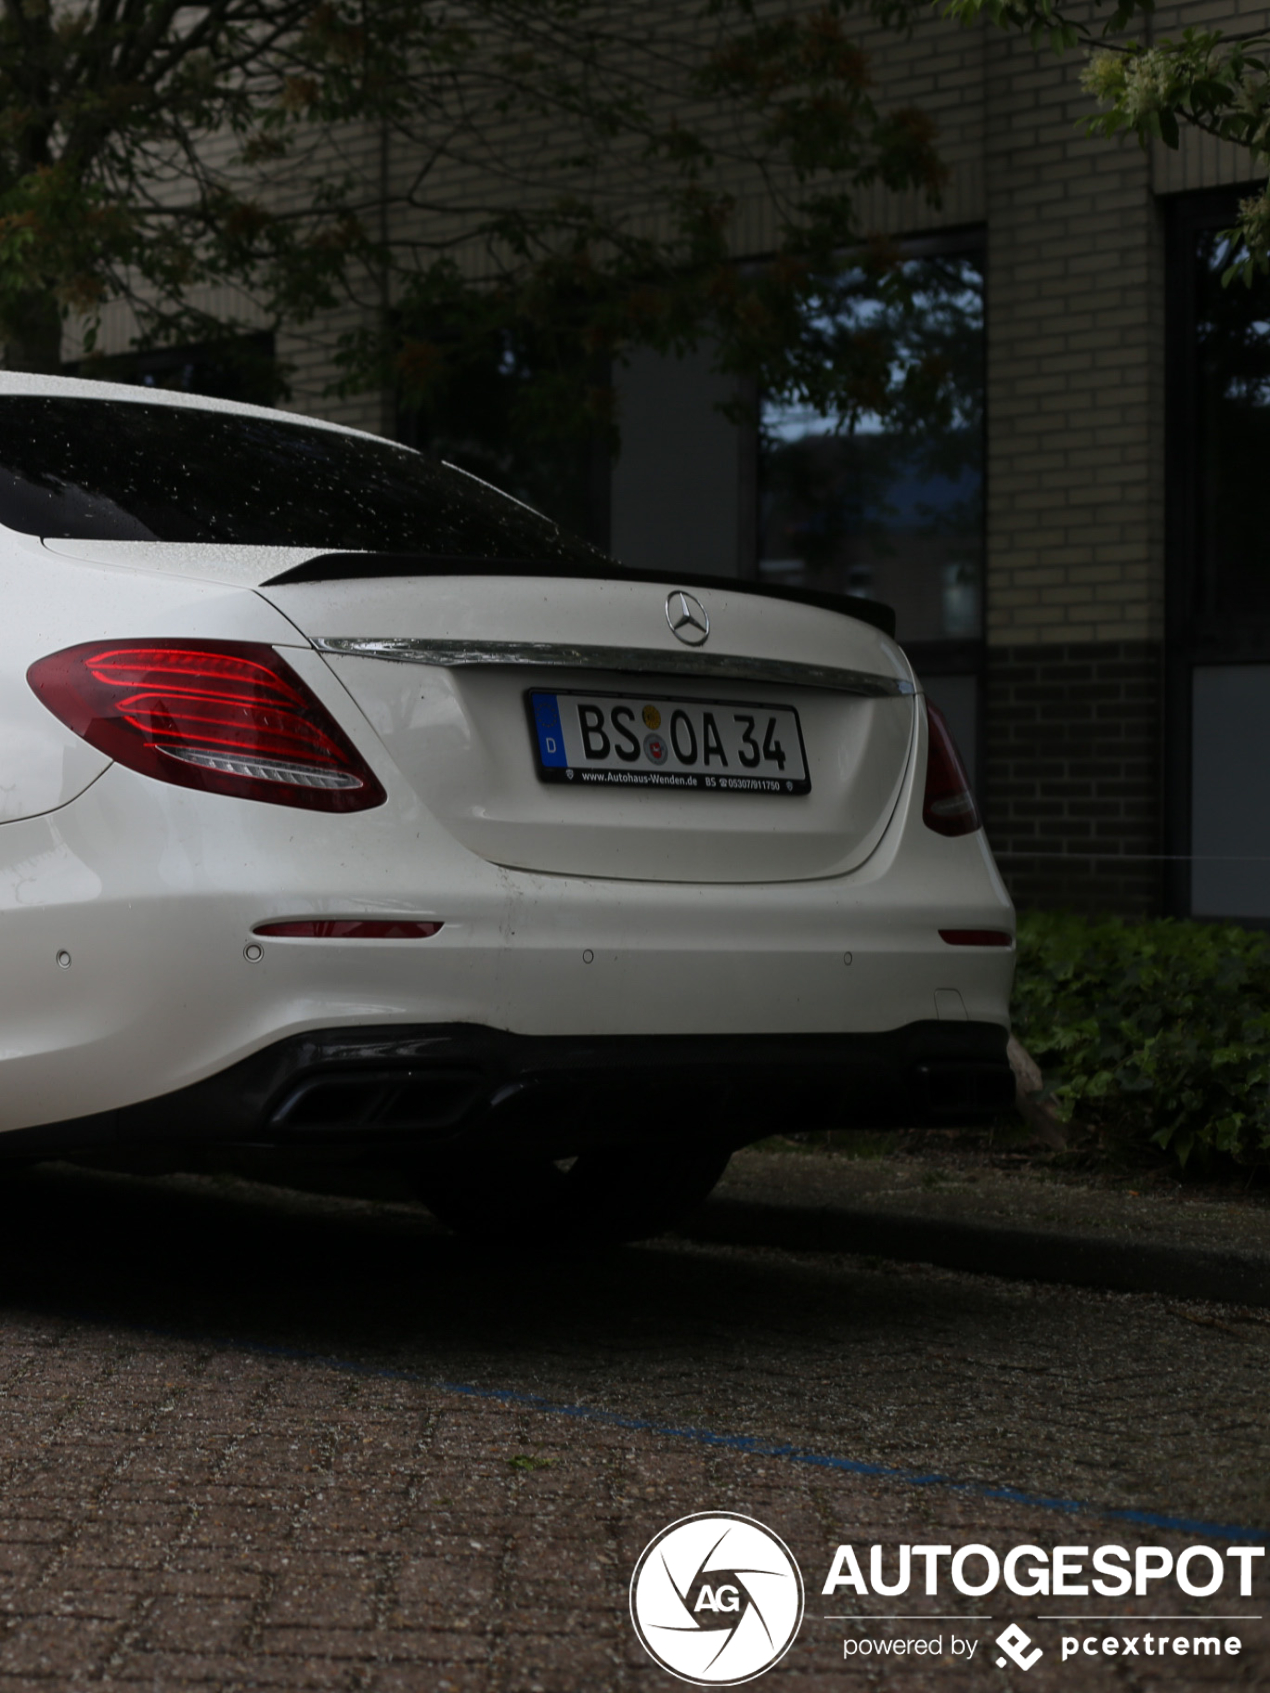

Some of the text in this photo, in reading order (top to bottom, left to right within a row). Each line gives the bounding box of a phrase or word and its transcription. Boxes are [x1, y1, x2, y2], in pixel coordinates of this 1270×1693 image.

[546, 737, 557, 753] D
[576, 704, 786, 771] BS OA 34
[582, 771, 698, 786] www.Autohaus-Wenden.de
